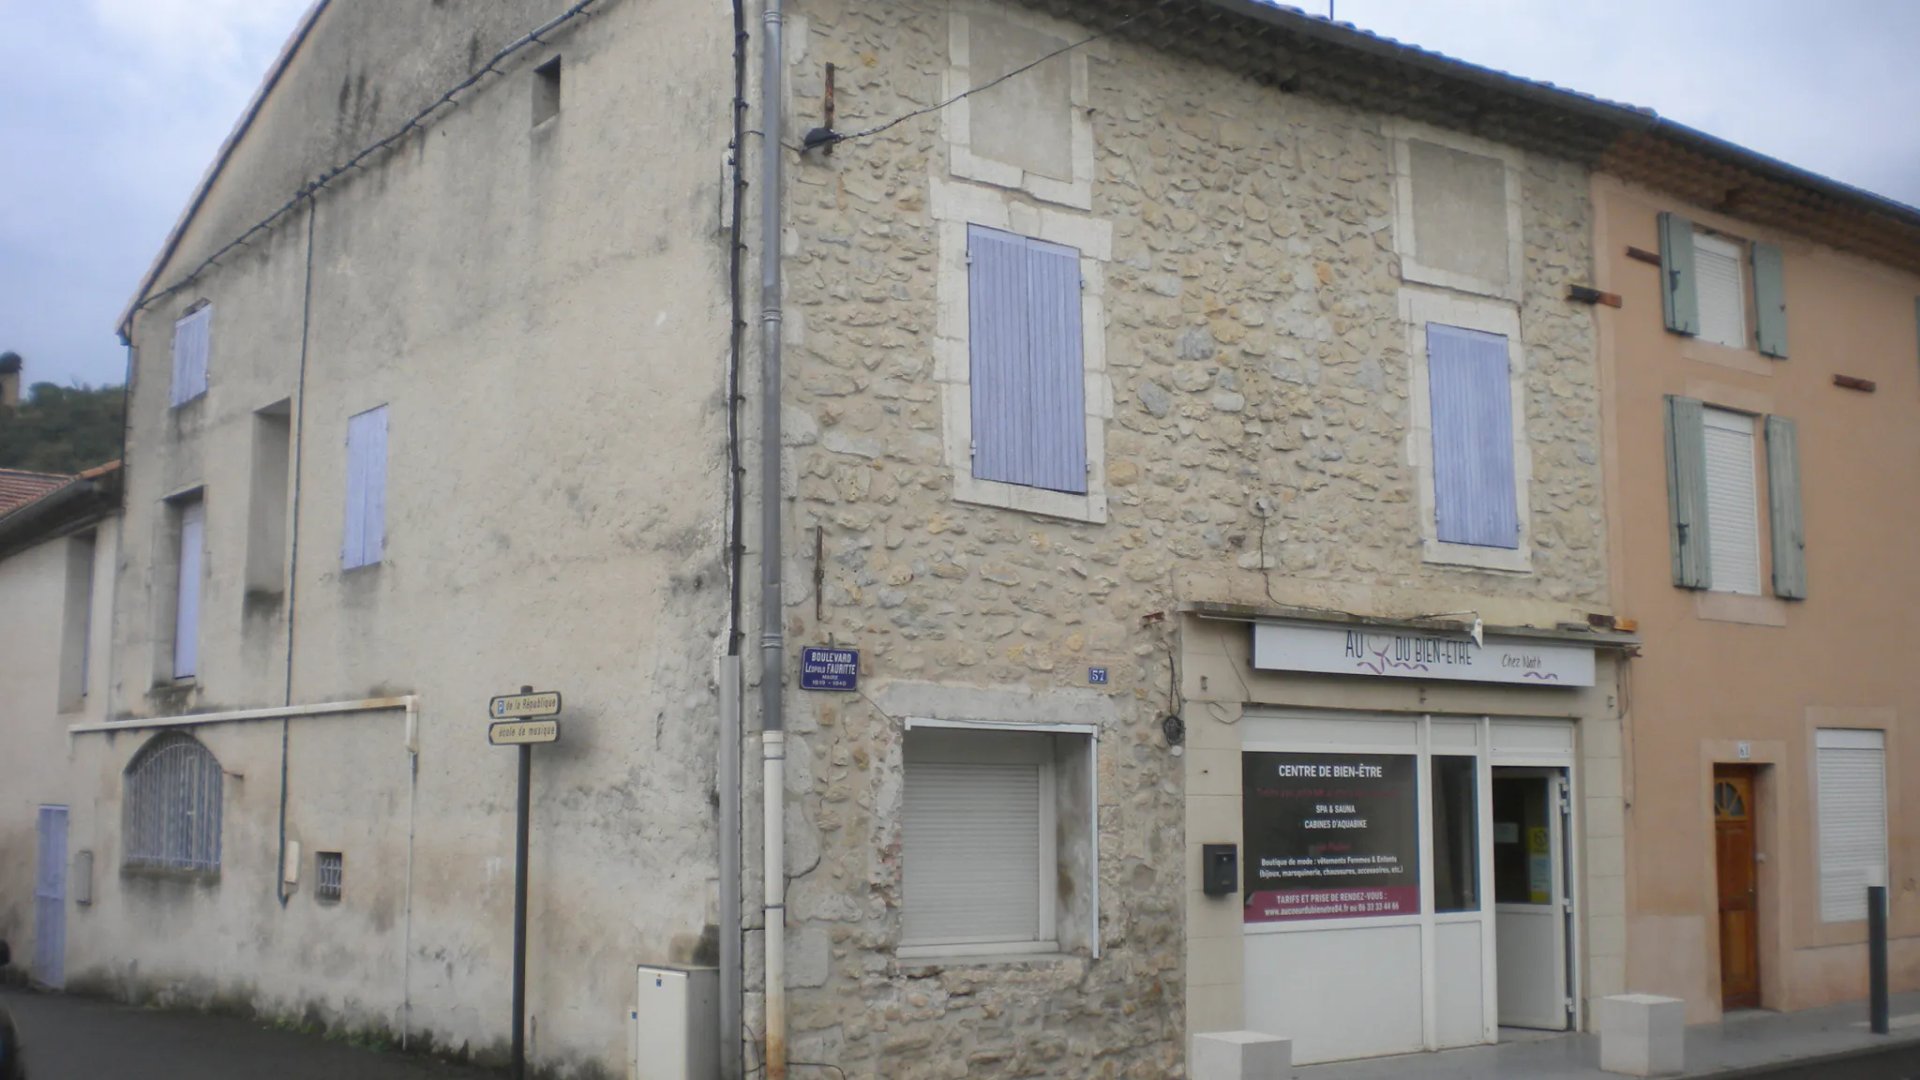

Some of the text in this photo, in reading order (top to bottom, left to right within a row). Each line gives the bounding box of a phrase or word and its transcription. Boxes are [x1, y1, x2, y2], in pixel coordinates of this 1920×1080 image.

[1345, 630, 1363, 658] AU
[1395, 636, 1411, 662] DU
[811, 652, 851, 663] BOULEVARD
[1502, 653, 1520, 668] Chez
[826, 663, 856, 675] FAURITTE
[1092, 670, 1105, 681] 57
[506, 700, 513, 711] de
[1278, 763, 1382, 778] CENTRE DE BIEN-ÊTRE
[1316, 805, 1328, 813] SPA
[1335, 805, 1356, 813] SAUNA
[1304, 820, 1331, 829] CABINES
[1261, 858, 1287, 867] Boutique
[1288, 858, 1296, 866] de
[1276, 894, 1300, 904] TARIFS
[1301, 894, 1310, 903] ET
[1310, 893, 1330, 903] PRISE
[1330, 893, 1339, 902] DE
[1340, 891, 1384, 901] RENDEZ-VOUS
